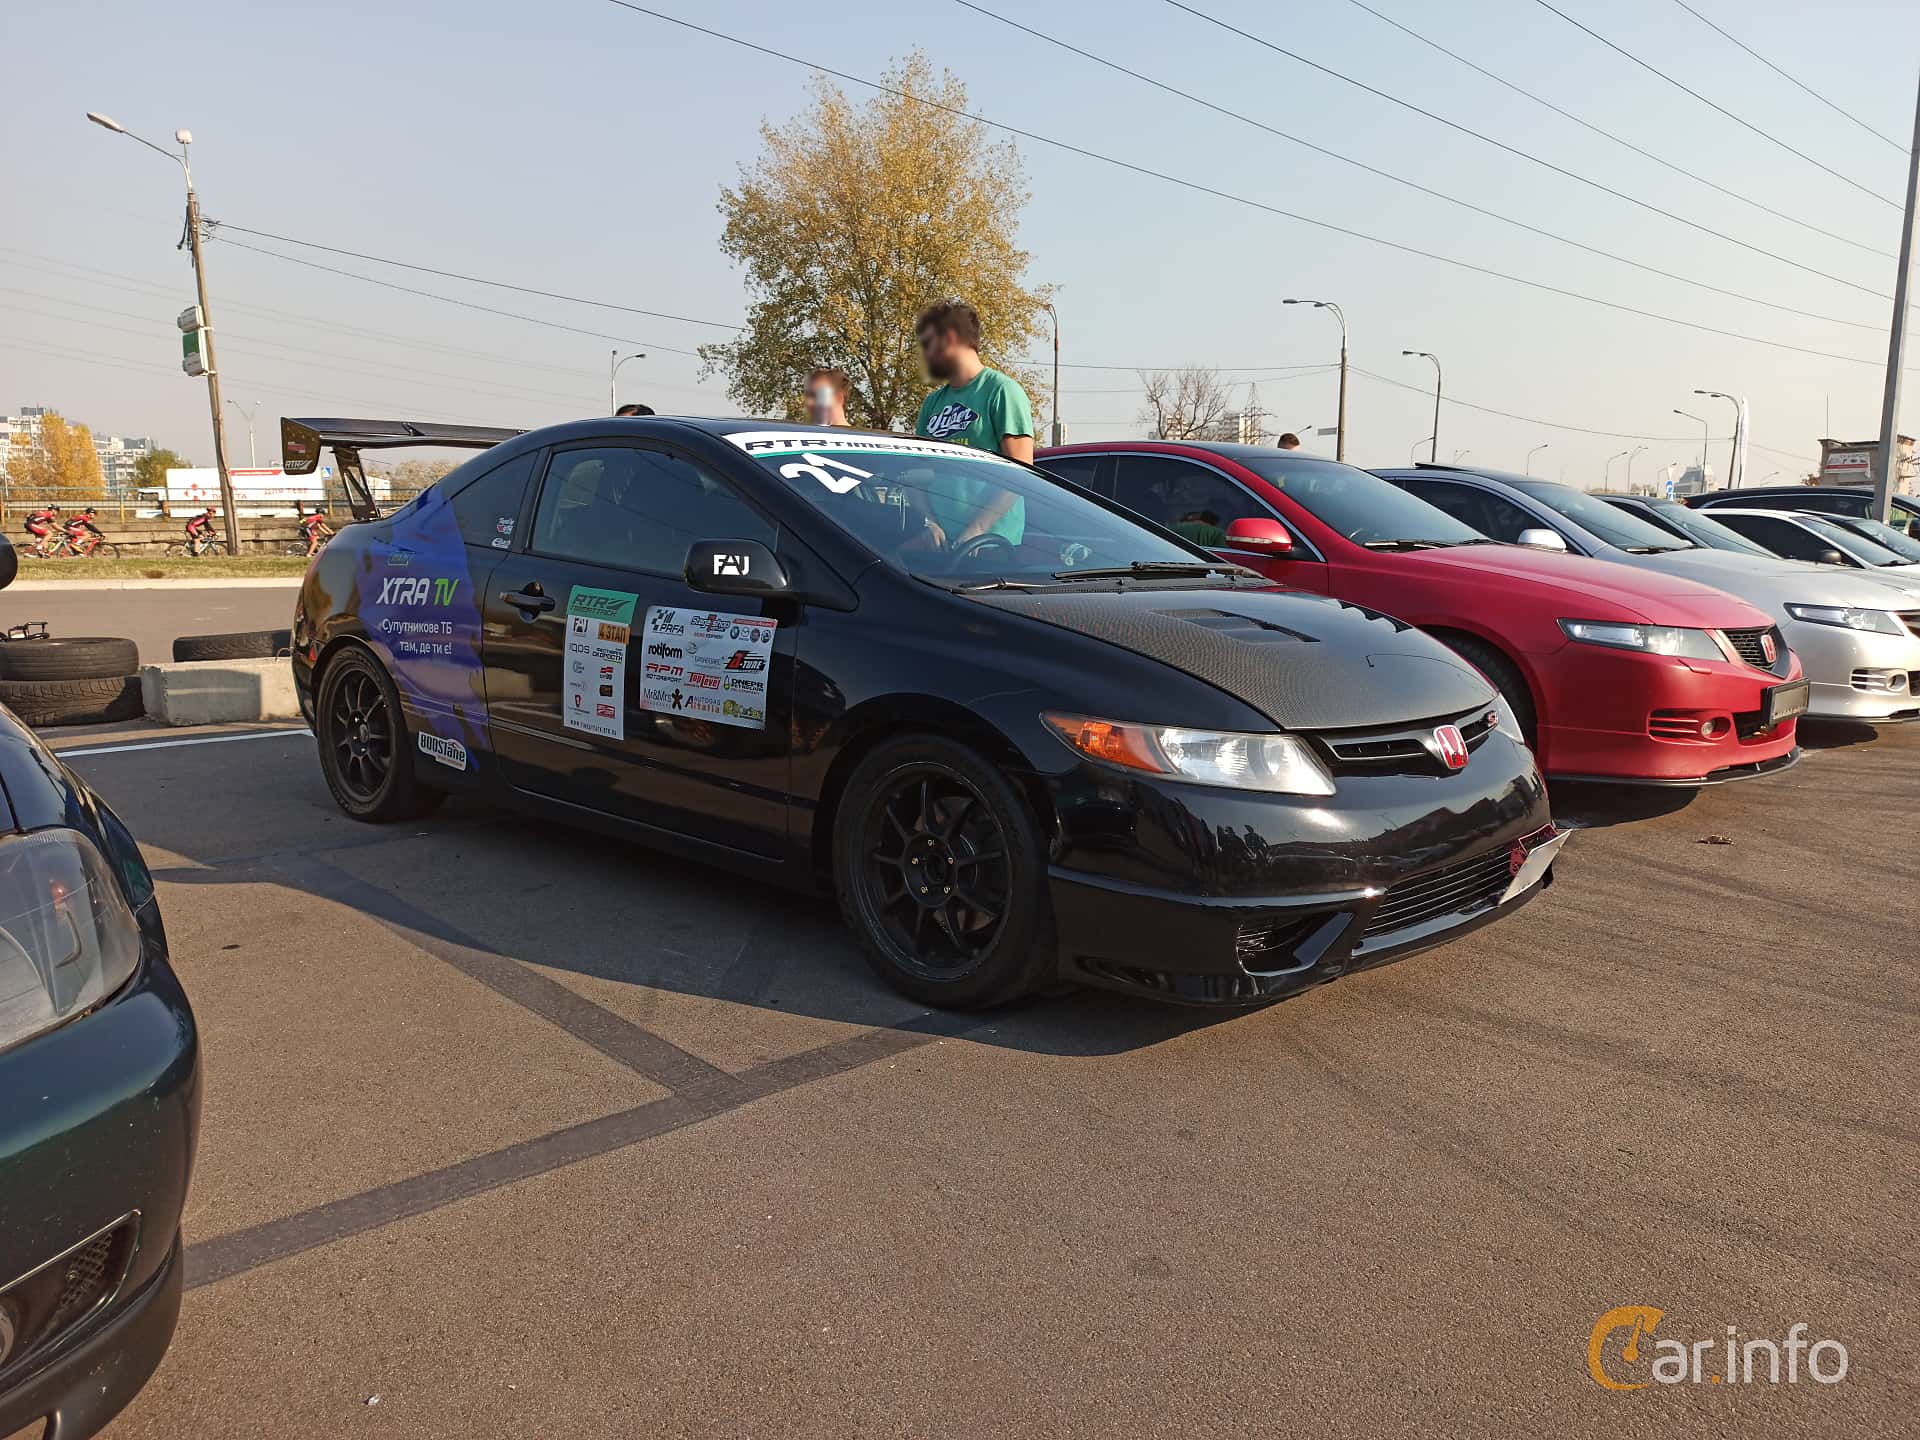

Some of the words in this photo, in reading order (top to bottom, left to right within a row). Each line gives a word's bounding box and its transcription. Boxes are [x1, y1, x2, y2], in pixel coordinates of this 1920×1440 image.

[745, 439, 828, 450] RTR
[779, 452, 874, 494] 21
[376, 577, 430, 606] XTRA
[434, 578, 459, 606] TV
[573, 594, 609, 609] RTR
[382, 619, 439, 635] Супутникове
[440, 621, 453, 634] ТБ
[660, 623, 684, 635] PRFA
[400, 641, 418, 654] там,
[420, 642, 431, 655] де
[432, 643, 443, 654] ти
[648, 642, 683, 660] rotiform
[731, 678, 764, 689] DNEPR
[643, 688, 672, 703] Mr&Mrs
